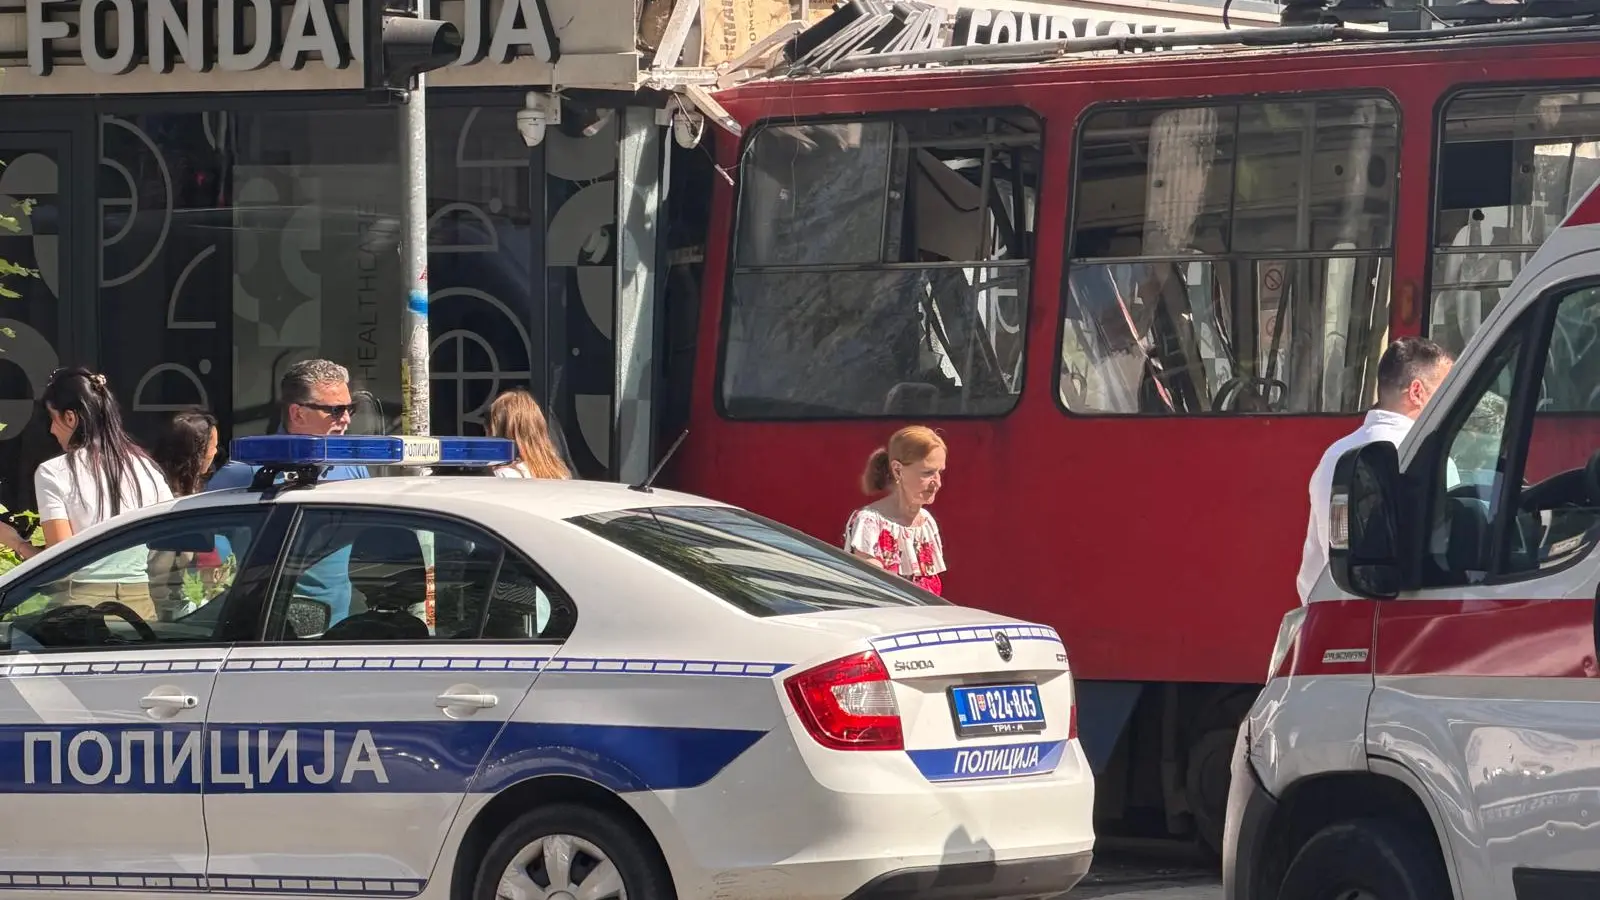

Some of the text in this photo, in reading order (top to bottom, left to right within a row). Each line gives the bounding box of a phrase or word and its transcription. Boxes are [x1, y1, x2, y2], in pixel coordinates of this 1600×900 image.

[29, 0, 553, 76] FONDAJA
[356, 202, 378, 381] HEALTHCARE
[23, 729, 390, 789] ПОЛИЦИЈА
[953, 745, 1040, 775] ПОЛИЦИЈА
